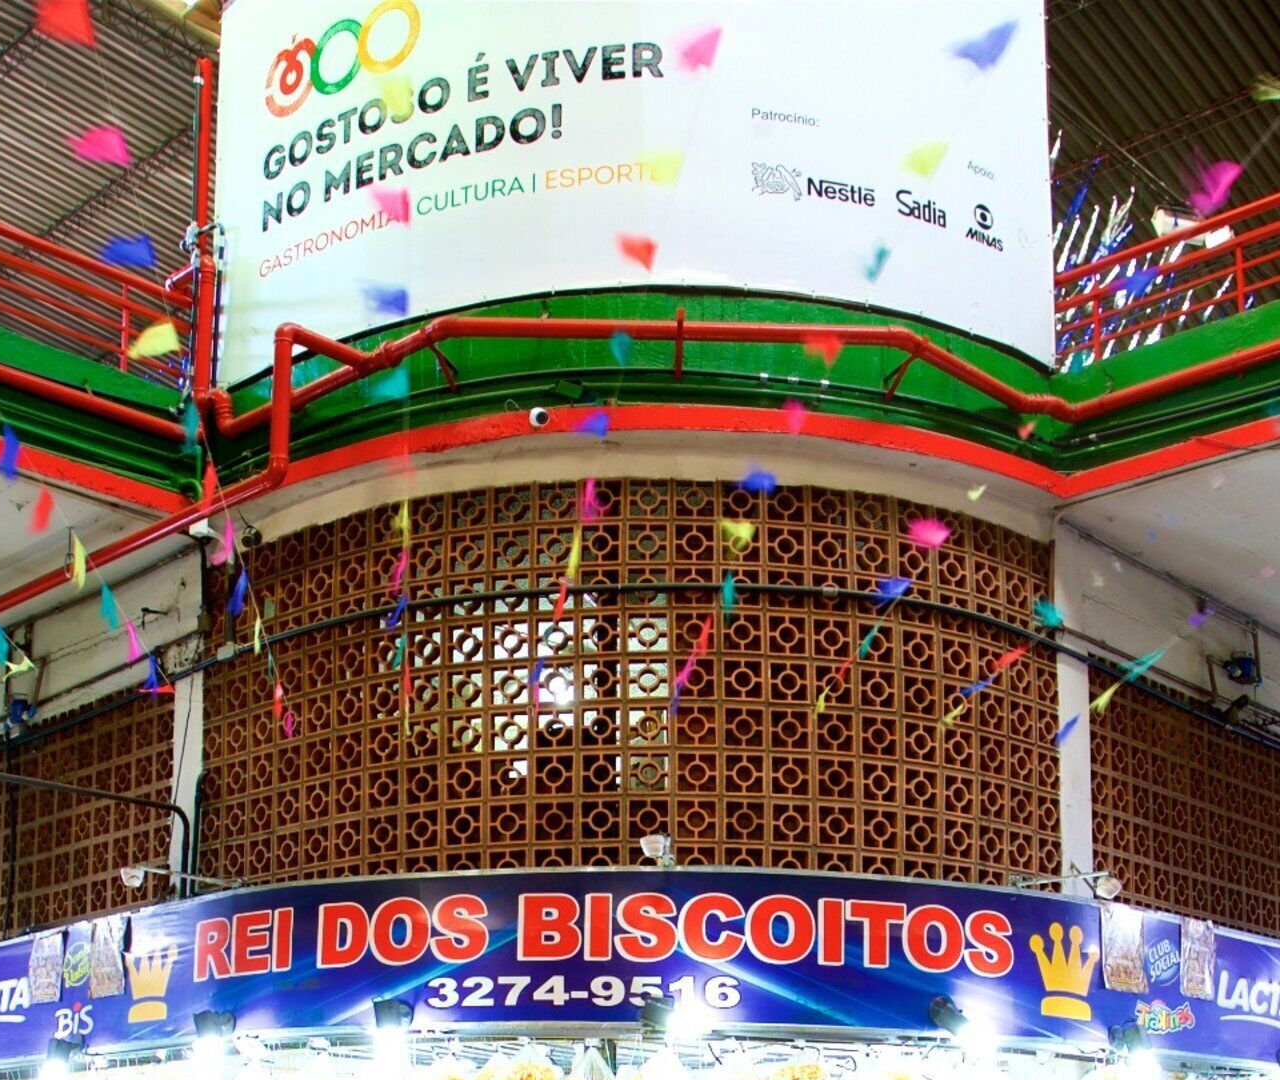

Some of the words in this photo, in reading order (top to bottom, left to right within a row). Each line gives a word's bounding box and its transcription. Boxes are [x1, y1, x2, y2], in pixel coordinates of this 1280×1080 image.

[263, 76, 451, 181] GOSTOSO
[467, 52, 490, 102] É
[506, 42, 664, 92] VIVER
[751, 107, 820, 128] Patrocínio:
[262, 180, 312, 232] NO
[324, 104, 562, 202] MERCADO!
[416, 175, 524, 217] CULTURA
[895, 189, 947, 228] Sadia
[965, 228, 1004, 252] MINAS
[194, 908, 293, 982] REI
[317, 893, 490, 968] DOS
[519, 891, 1015, 977] BISCOITOS
[1148, 939, 1171, 962] CLUB
[1150, 951, 1181, 983] SOCIAL
[426, 974, 742, 1010] 3274-9516
[1135, 999, 1196, 1035] Trakinas
